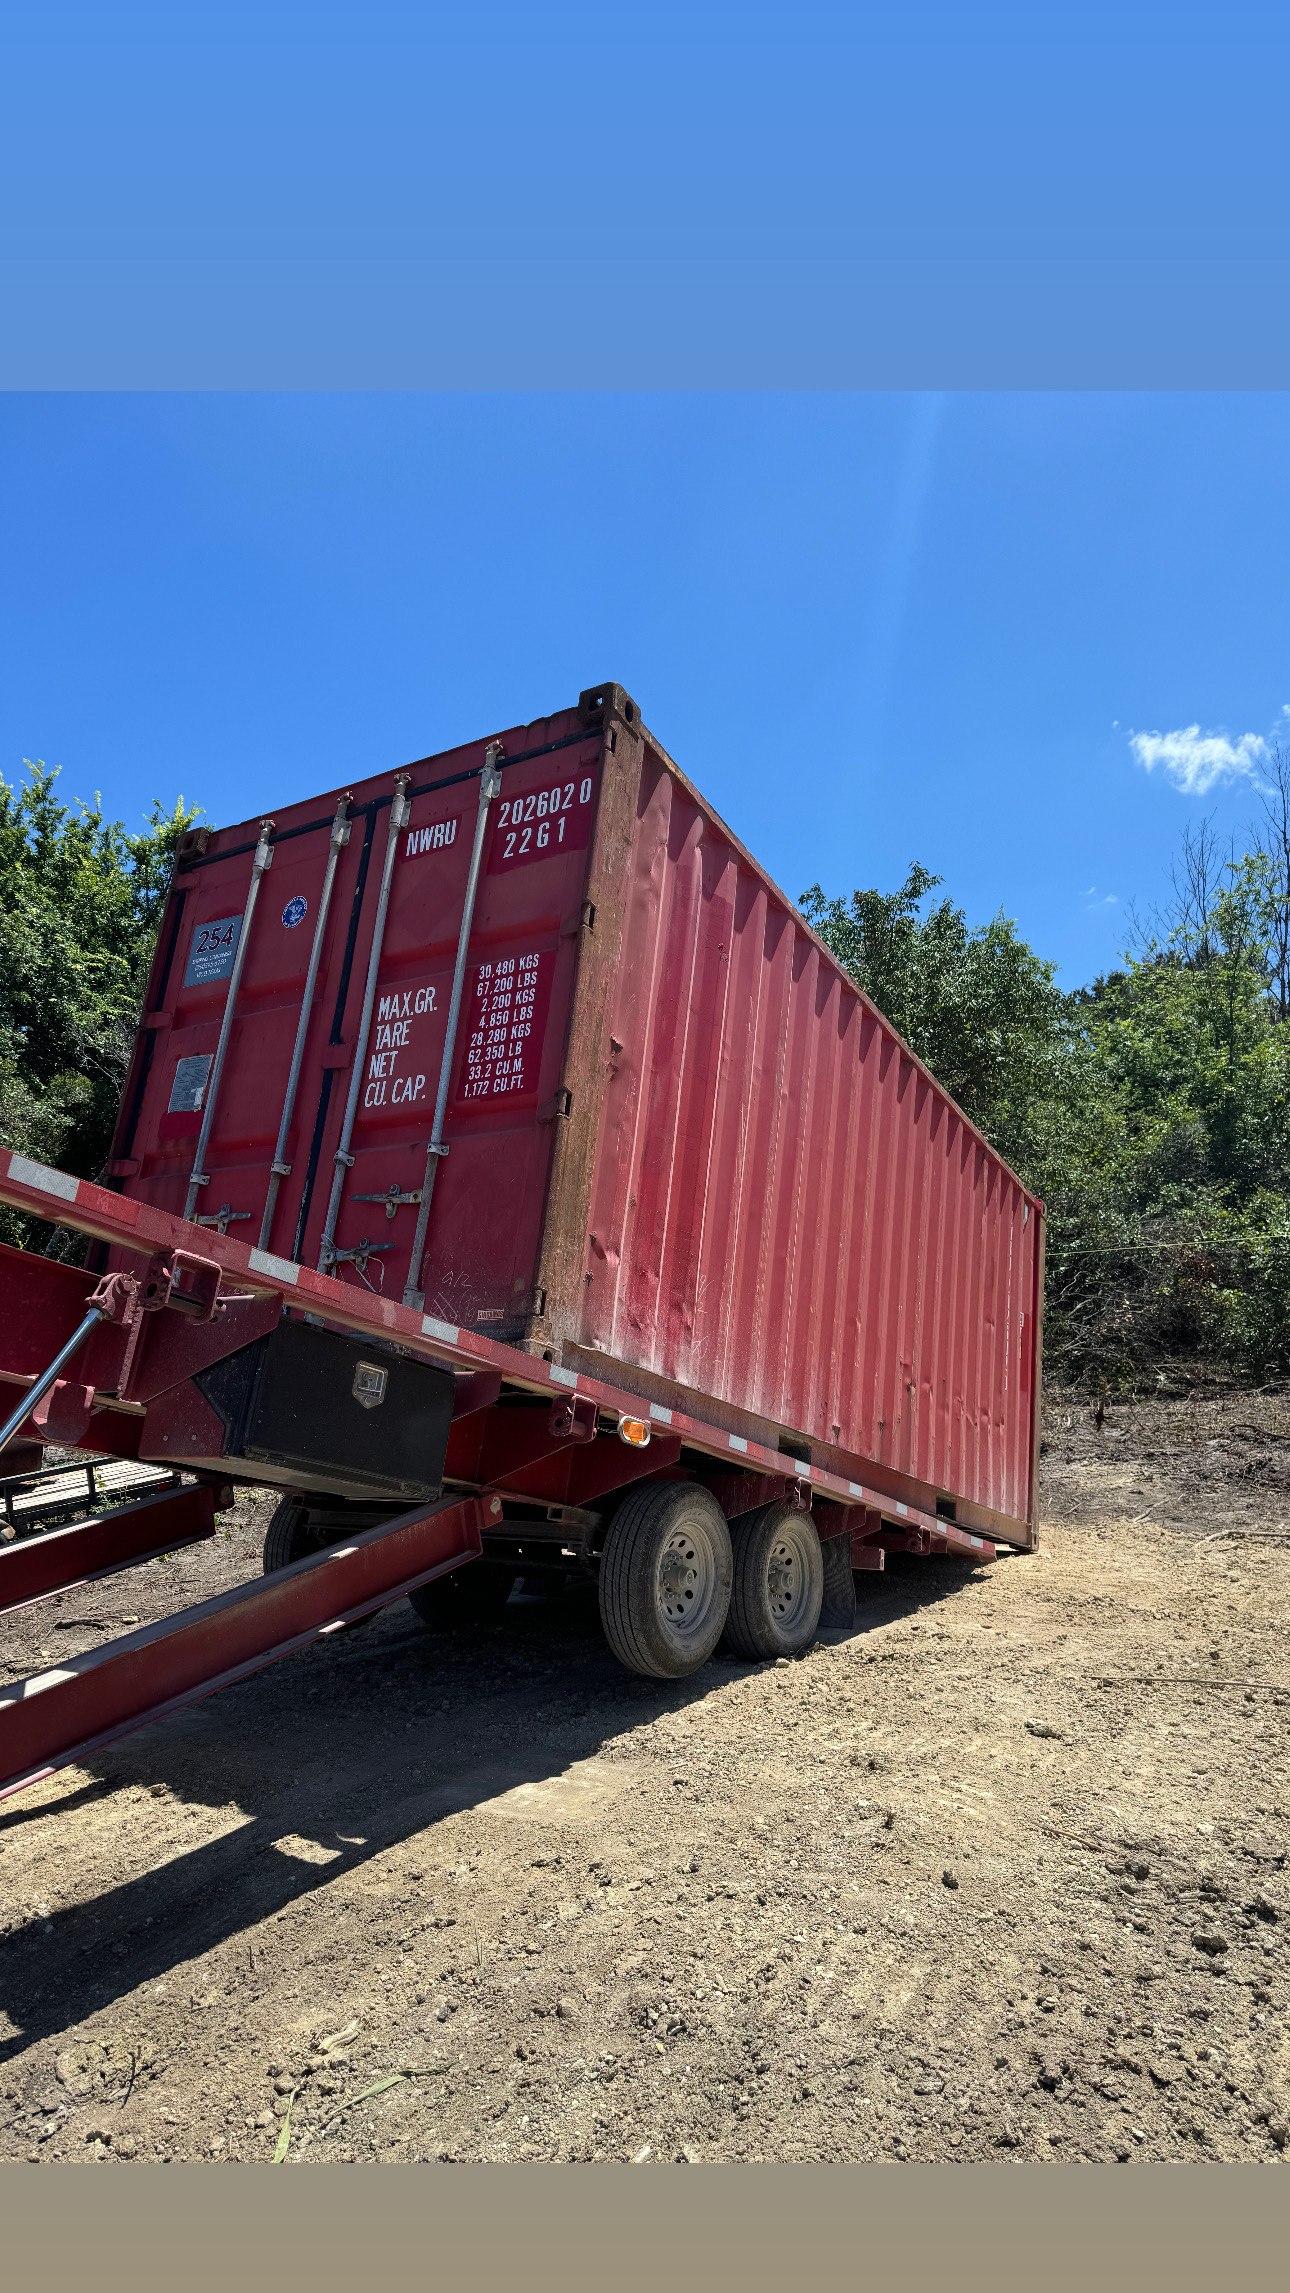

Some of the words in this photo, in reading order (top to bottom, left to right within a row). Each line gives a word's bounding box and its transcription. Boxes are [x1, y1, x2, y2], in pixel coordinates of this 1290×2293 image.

[406, 819, 457, 857] NWRU
[195, 922, 234, 954] 254
[479, 959, 515, 980] 30,480
[519, 953, 540, 971] KGS
[476, 976, 513, 997] 67,200
[517, 971, 538, 987] LBS
[377, 986, 438, 1022] MAX.GR.
[481, 993, 511, 1012] 2,200
[515, 988, 536, 1005] KGS
[479, 1010, 509, 1029] 4,850
[513, 1005, 534, 1022] LBS
[375, 1019, 413, 1050] TARE
[470, 1027, 507, 1047] 28,280
[510, 1022, 532, 1040] KGS
[368, 1050, 399, 1079] NET
[468, 1045, 505, 1064] 62,350
[508, 1041, 523, 1057] LB
[468, 1063, 491, 1081] 33.2
[495, 1057, 525, 1075] CU.M.
[364, 1081, 387, 1108] CU.
[391, 1074, 426, 1104] CAP.
[464, 1080, 488, 1098] 1,172
[492, 1074, 524, 1093] CU.FT.
